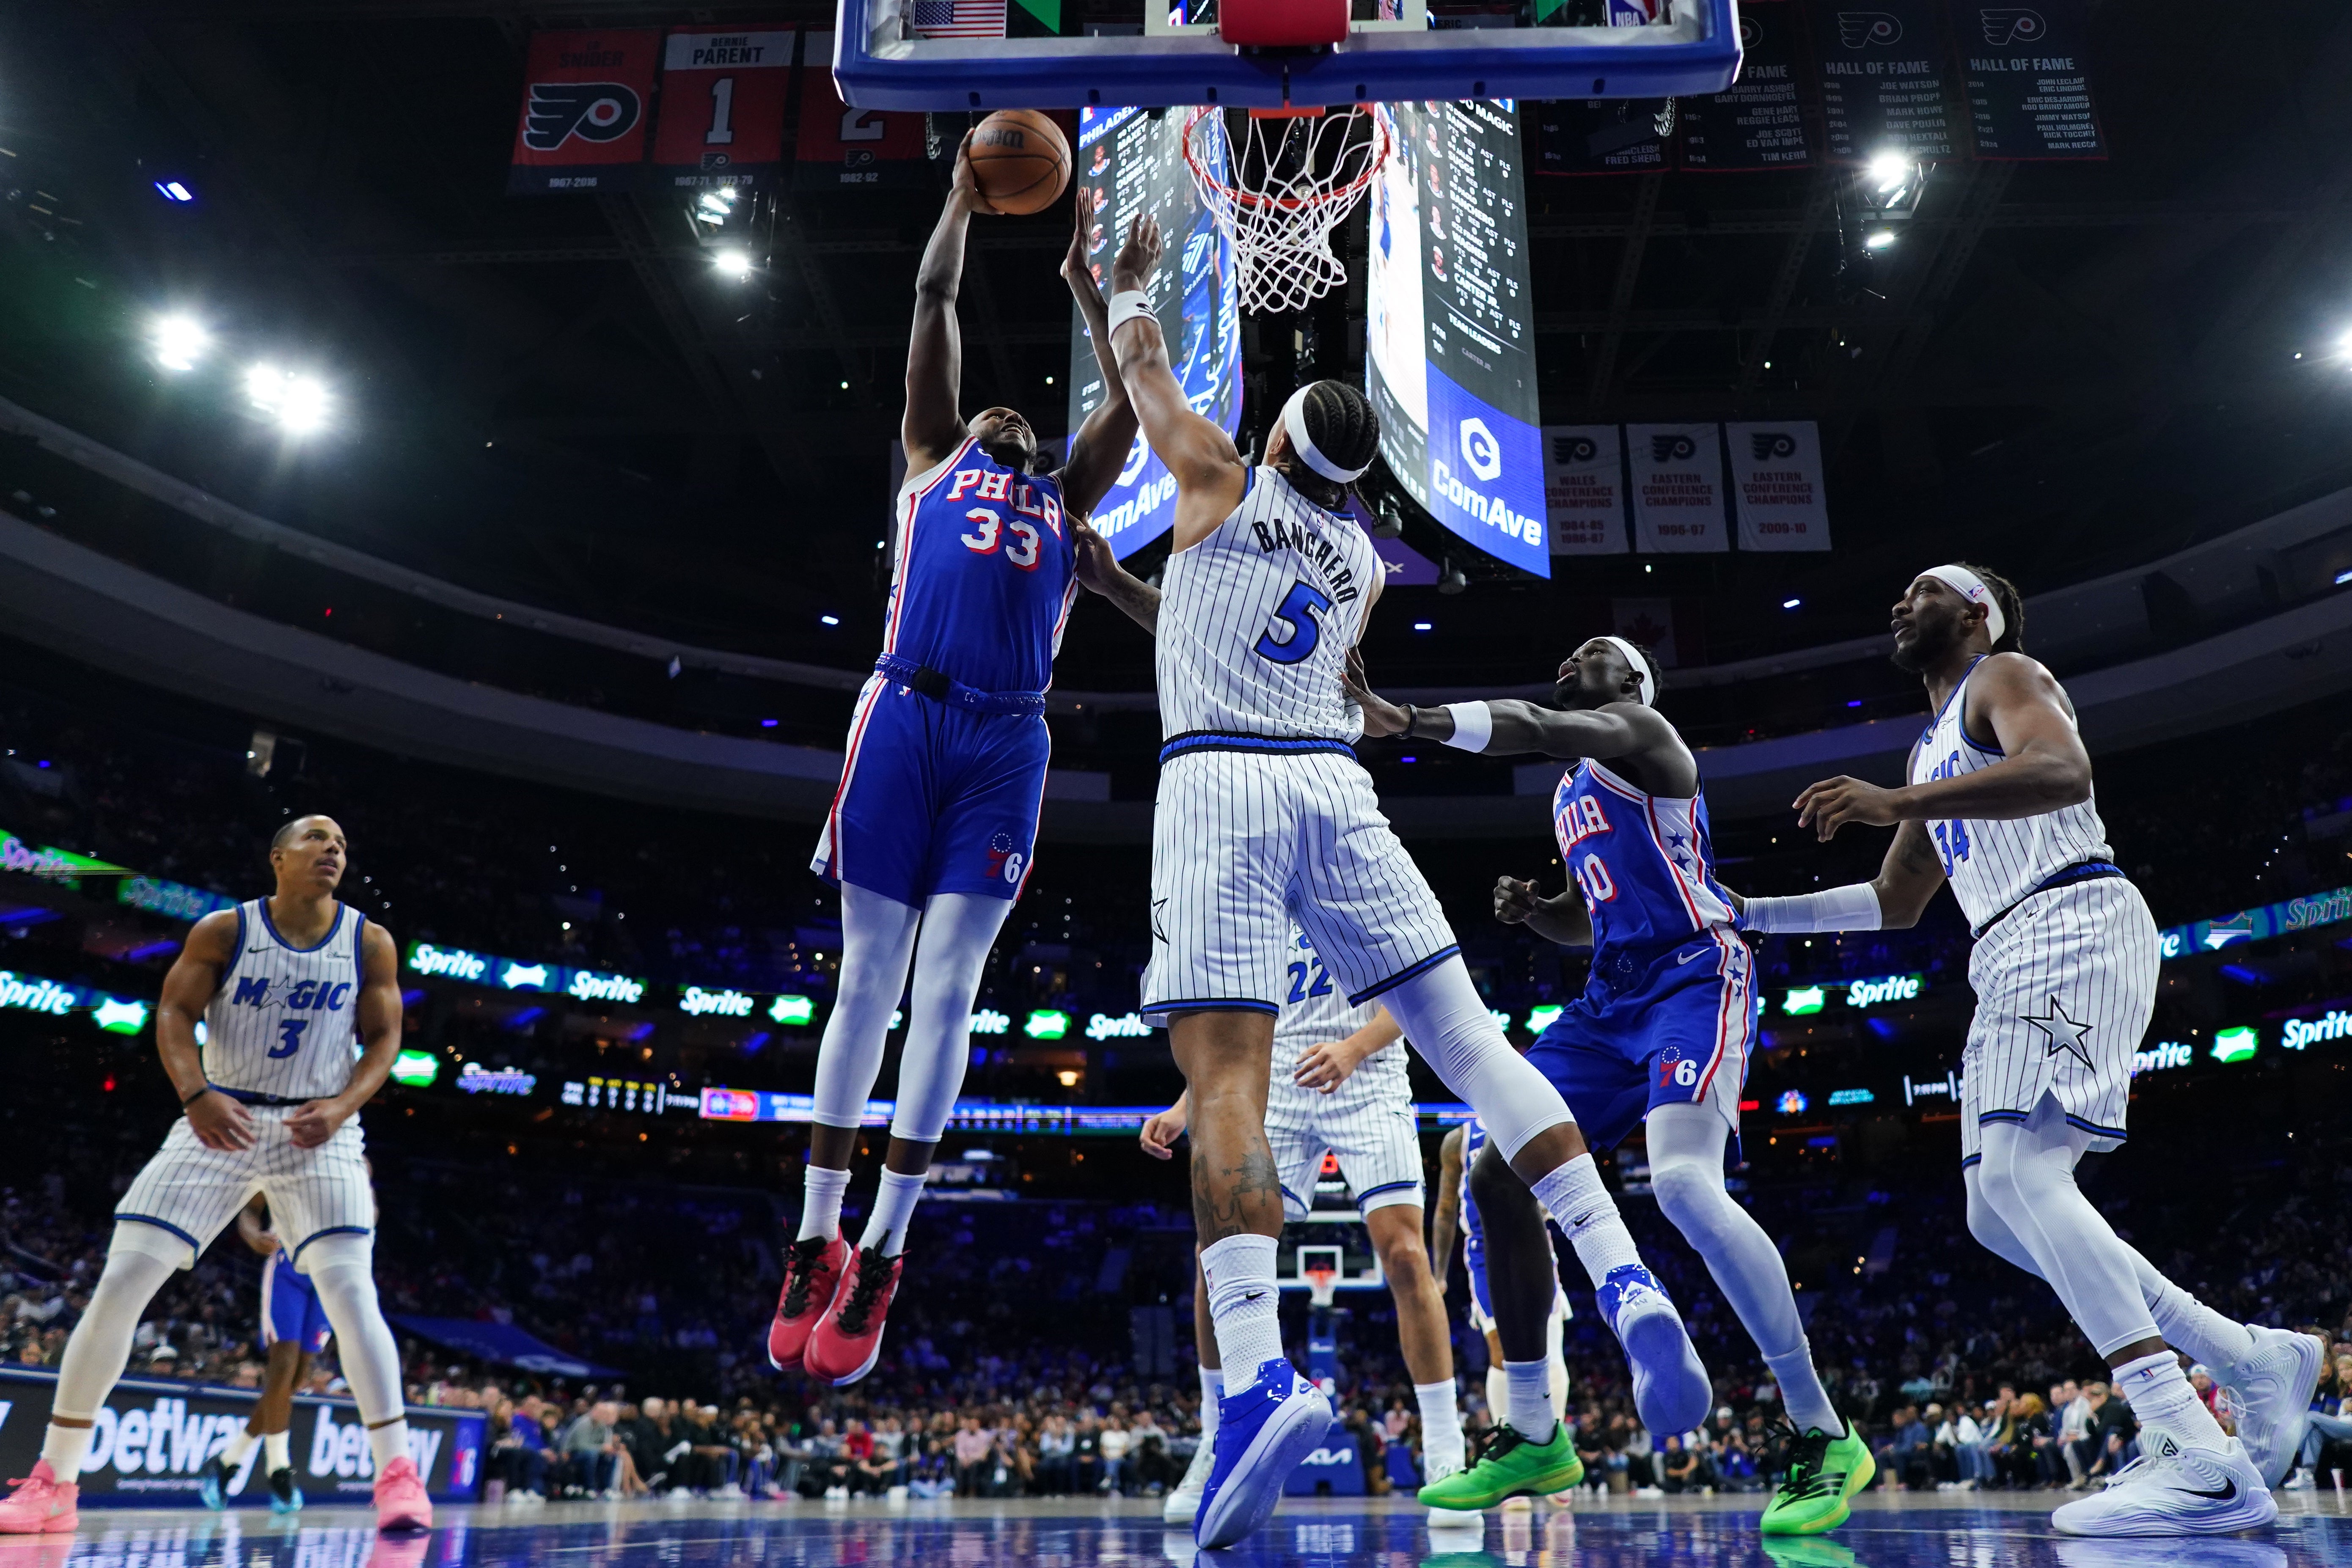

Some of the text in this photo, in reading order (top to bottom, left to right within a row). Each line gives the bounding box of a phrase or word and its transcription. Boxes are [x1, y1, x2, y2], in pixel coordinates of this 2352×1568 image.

[1615, 11, 1640, 26] NBA
[711, 37, 748, 47] BERNIE
[559, 51, 625, 69] SNIDER
[693, 47, 764, 65] PARENT
[1970, 57, 2075, 72] HALL OF FAME
[1747, 65, 1788, 79] FAME
[1825, 61, 1930, 75] HALL OF FAME
[1880, 80, 1940, 90] JOE WATSON
[1714, 94, 1740, 103] GARY
[1879, 94, 1909, 103] BRIAN
[2038, 102, 2091, 110] BRIND'AMOUR
[2044, 95, 2089, 103] DESJARDINS
[705, 77, 734, 144] 1
[1752, 107, 1775, 116] GENE
[1886, 105, 1943, 116] MARK HOWE
[1079, 106, 1137, 148] PHILADEL
[1446, 110, 1468, 135] BANE
[1475, 104, 1514, 136] MAGIC
[1737, 116, 1771, 125] REGGIE
[1117, 121, 1147, 152] MAXEY
[1756, 127, 1802, 139] JOE SCOTT
[1746, 139, 1758, 148] ED
[1760, 138, 1780, 147] VAN
[1447, 150, 1475, 177] SUGGS
[1605, 155, 1629, 165] FRED
[1761, 152, 1780, 162] TIM
[1450, 190, 1495, 228] BANCHERO
[1452, 230, 1488, 263] WAGNER
[1458, 256, 1463, 265] 2
[1454, 272, 1500, 310] CARTER JR.
[1448, 312, 1502, 355] TEAM LEADERS
[1494, 320, 1499, 329] 1
[1560, 475, 1596, 486] WALES
[1652, 474, 1702, 484] EASTERN
[1753, 472, 1802, 482] EASTERN
[1545, 487, 1613, 498] CONFERENCE
[1642, 485, 1713, 495] CONFERENCE
[1743, 483, 1813, 494] CONFERENCE
[1088, 471, 1177, 539] omAve
[1433, 458, 1542, 547] ComAve
[1546, 498, 1612, 509] CHAMPIONS
[1645, 496, 1711, 507] CHAMPIONS
[1747, 494, 1813, 505] CHAMPIONS
[1759, 522, 1807, 534] 2009-10
[960, 507, 1043, 572] 33
[1252, 518, 1357, 604] BANCHERO
[1253, 578, 1334, 665] 5
[1555, 794, 1613, 858] HILA
[1934, 819, 1970, 878] 34
[986, 848, 1023, 884] 76
[409, 943, 486, 980] Sprite
[569, 970, 644, 1003] Sprite
[1287, 957, 1333, 1004] 22
[0, 971, 76, 1015] Sprite
[679, 986, 754, 1017] Sprite
[1846, 976, 1920, 1009] Sprite
[968, 1009, 1010, 1034] rite
[267, 1019, 308, 1059] 3
[2132, 1041, 2192, 1074] prite
[456, 1062, 537, 1096] Sprite
[1659, 1059, 1697, 1088] 76
[308, 1405, 443, 1486] betay
